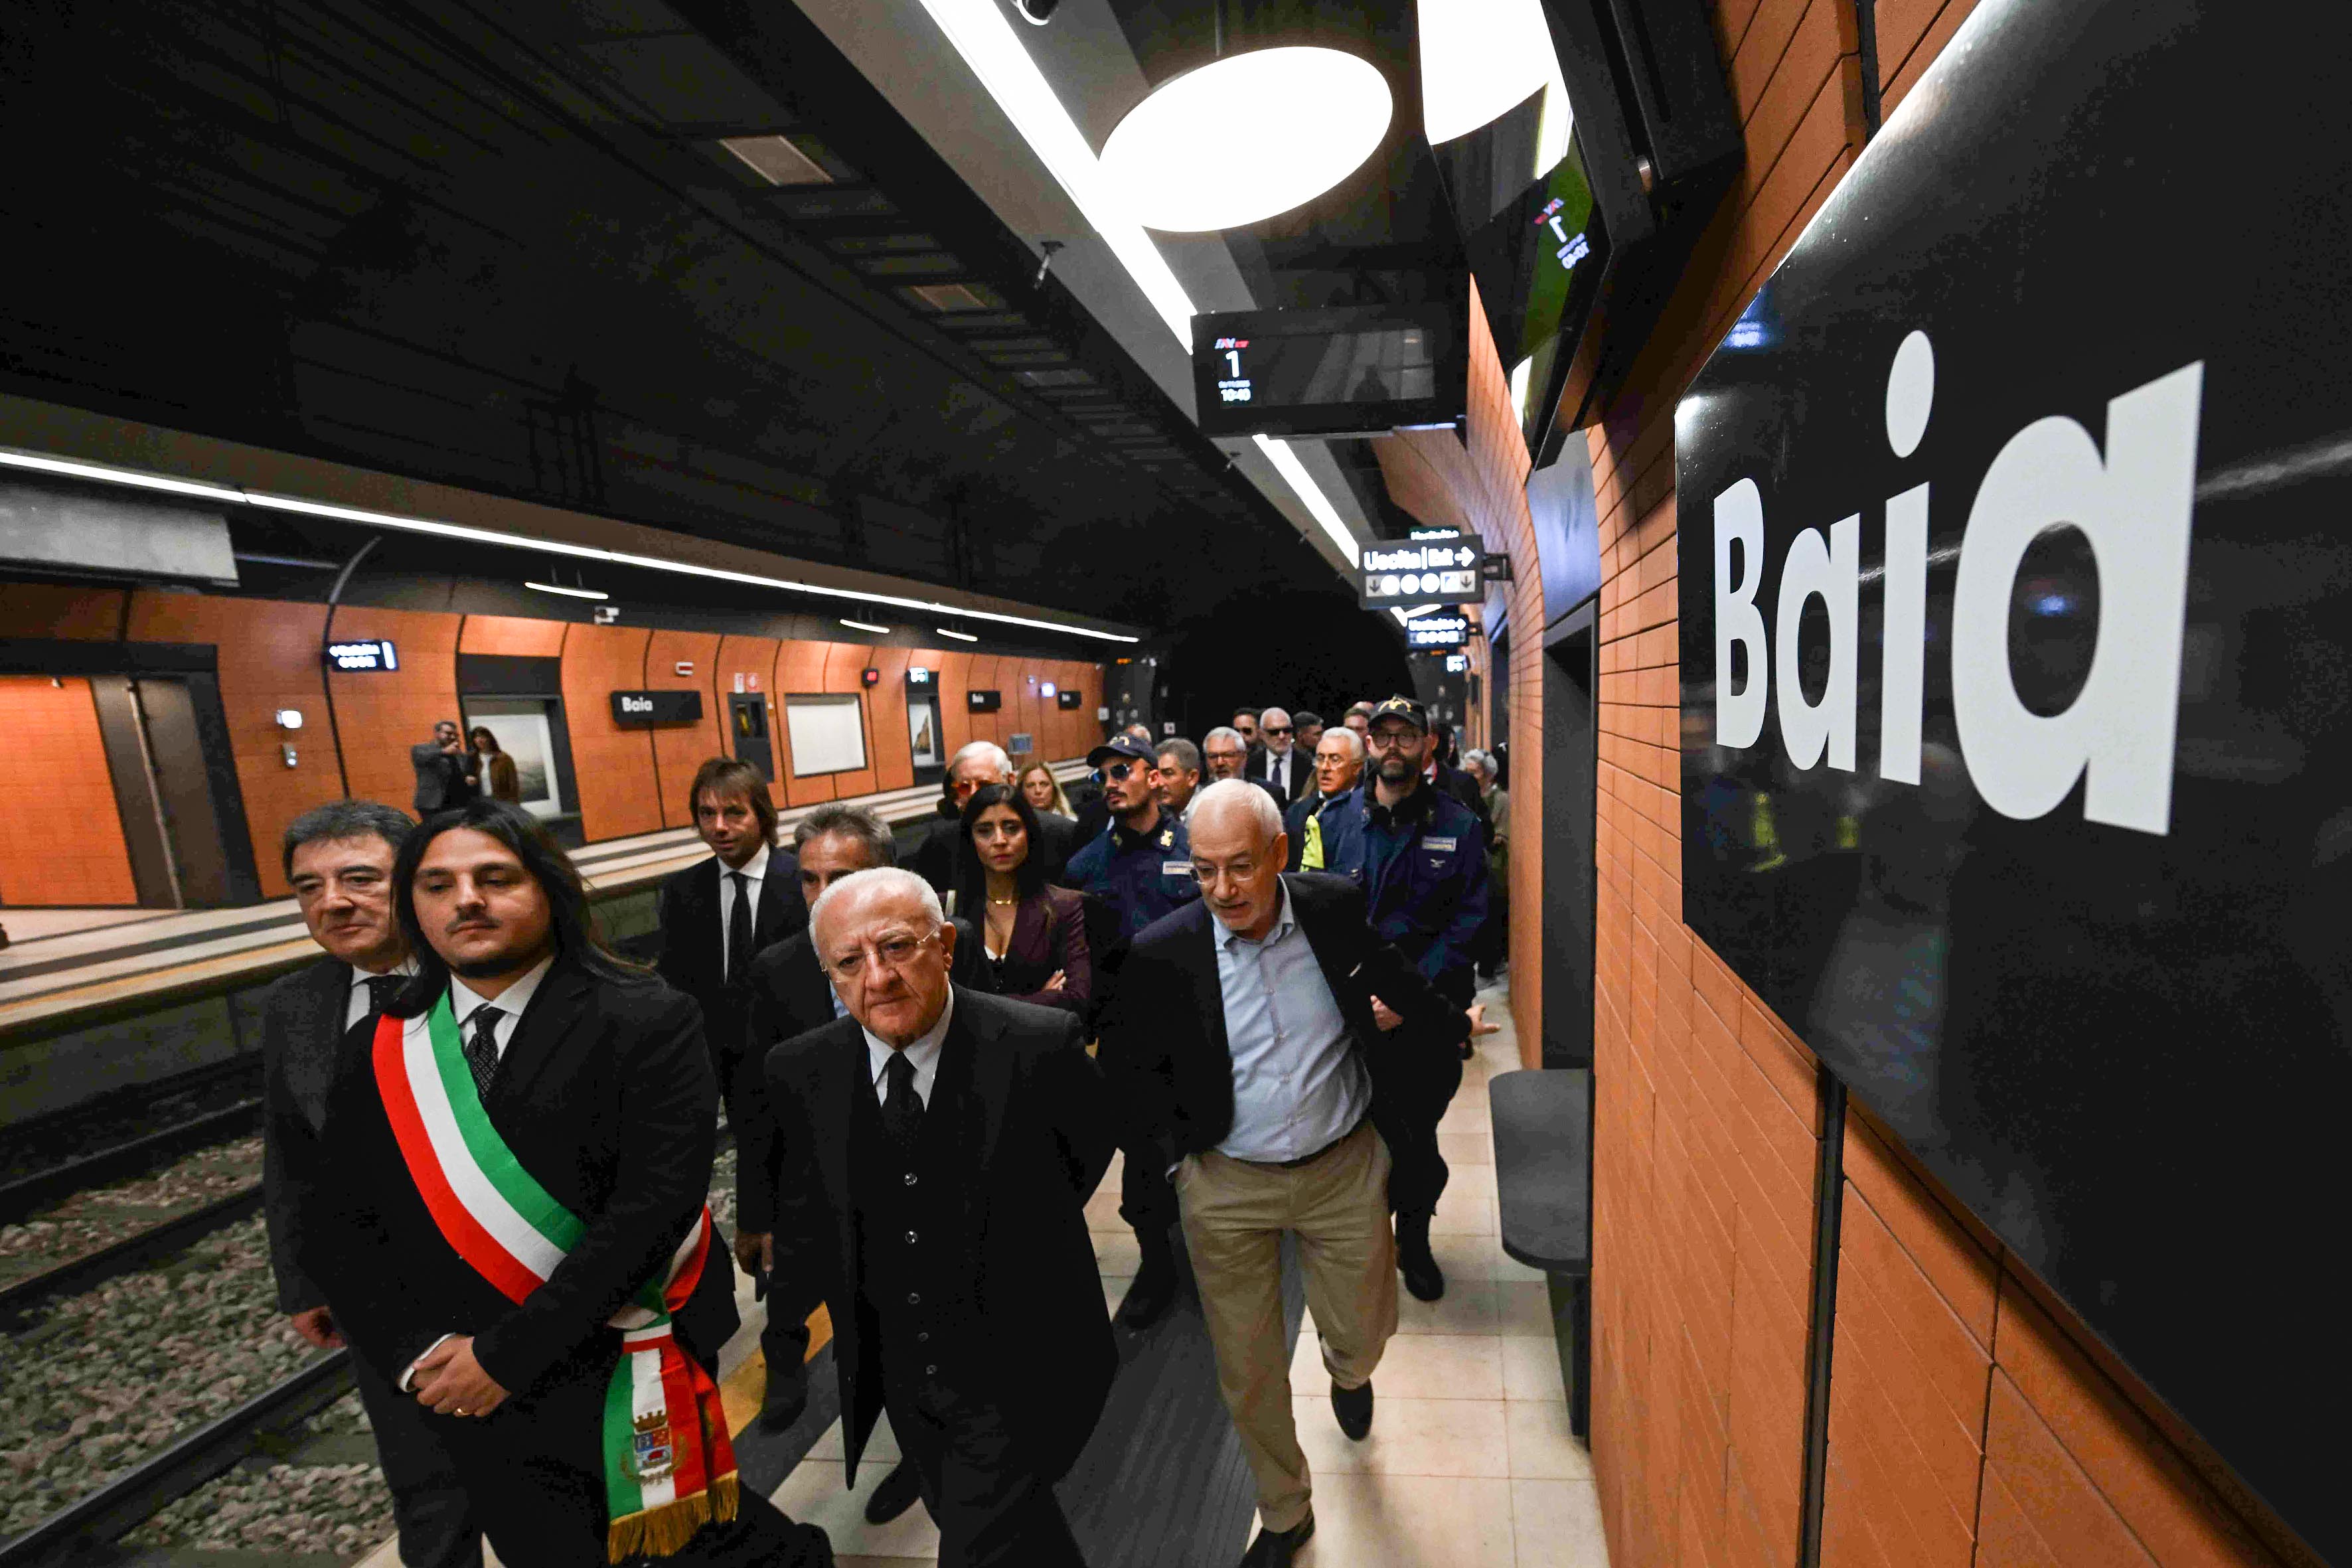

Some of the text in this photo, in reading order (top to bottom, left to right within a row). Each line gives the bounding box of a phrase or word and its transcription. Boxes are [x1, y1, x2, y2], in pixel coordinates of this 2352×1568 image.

[1225, 350, 1239, 378] 1
[1713, 330, 2205, 836] Baia
[621, 696, 653, 712] Baia
